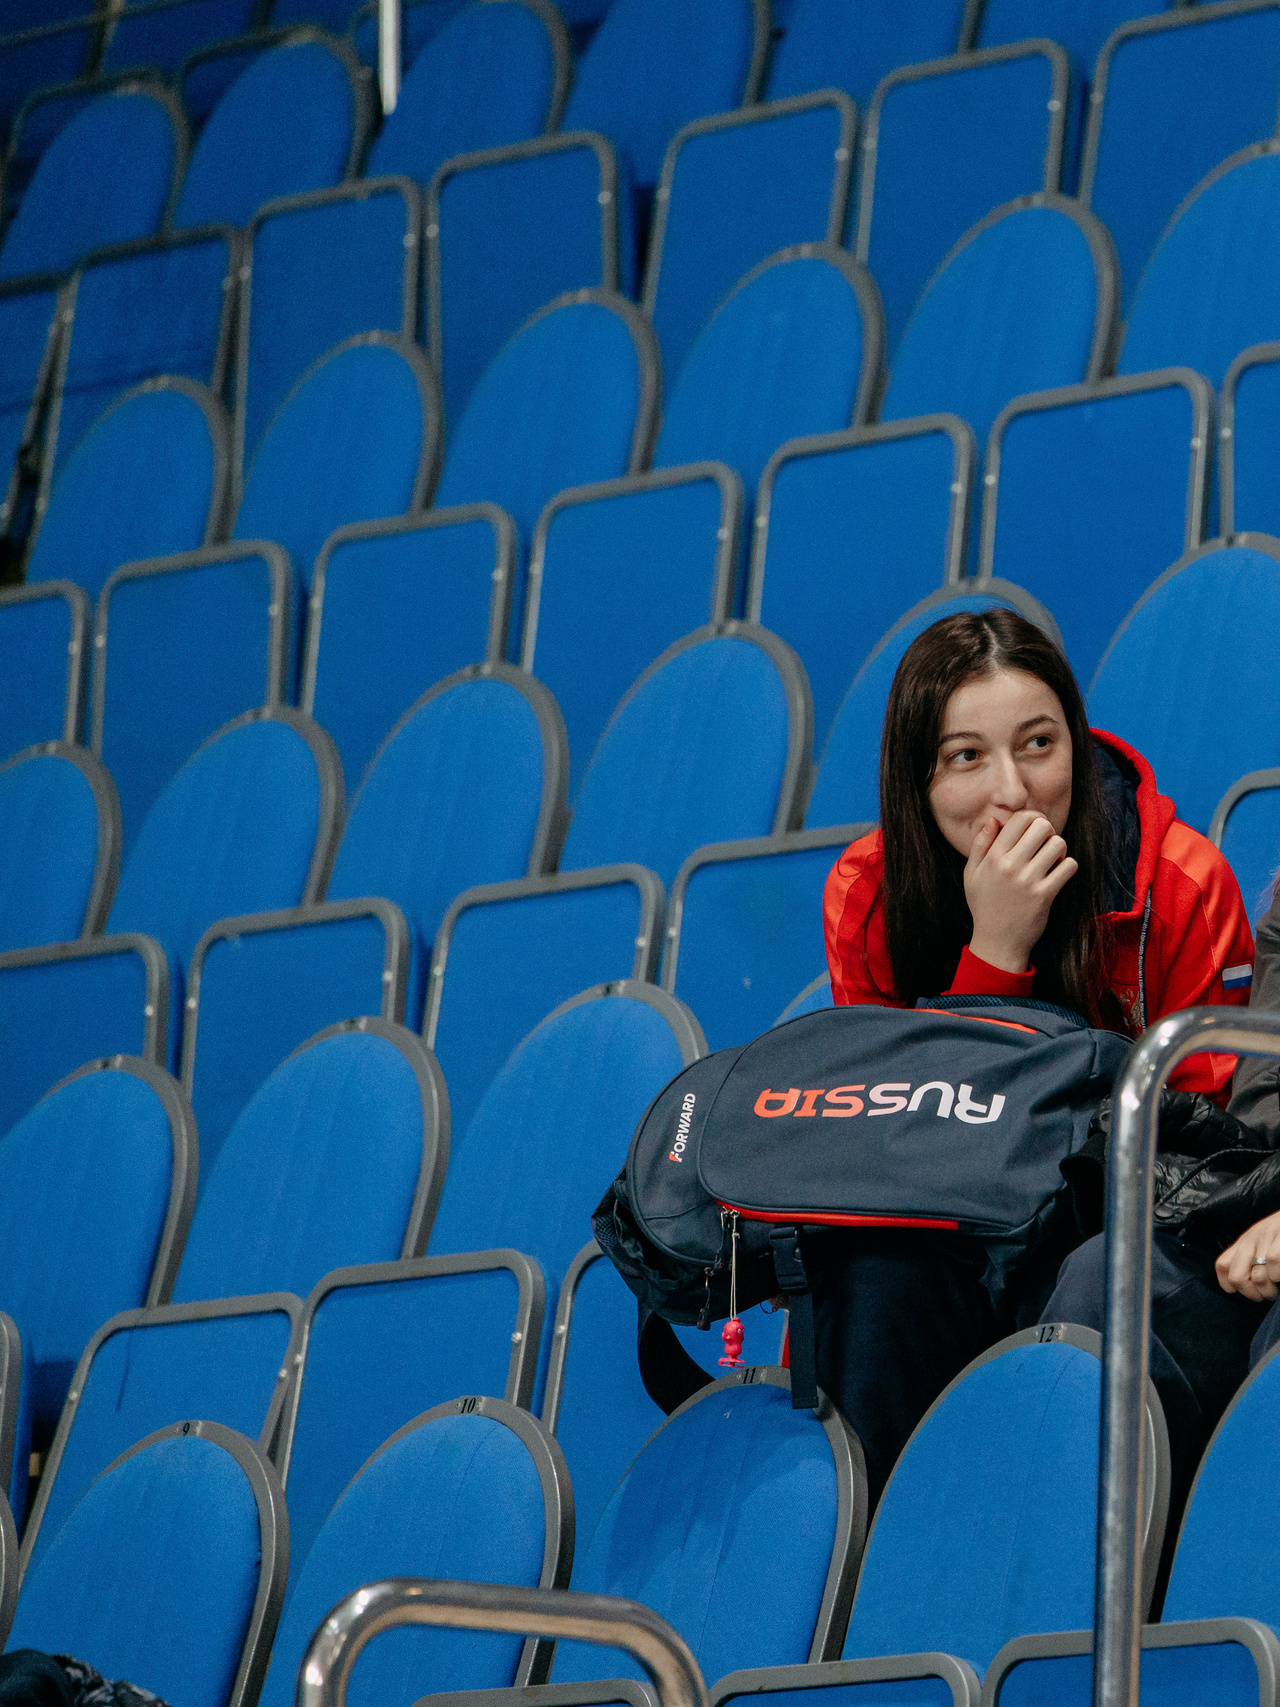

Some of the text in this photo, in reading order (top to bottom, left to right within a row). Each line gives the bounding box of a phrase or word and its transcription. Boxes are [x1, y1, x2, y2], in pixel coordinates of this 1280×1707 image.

[754, 1080, 1006, 1124] RUSSIA
[669, 1093, 696, 1162] FORWARD
[1039, 1326, 1055, 1343] 12
[742, 1367, 756, 1384] 11
[460, 1398, 476, 1413] 10
[182, 1422, 190, 1437] 9
